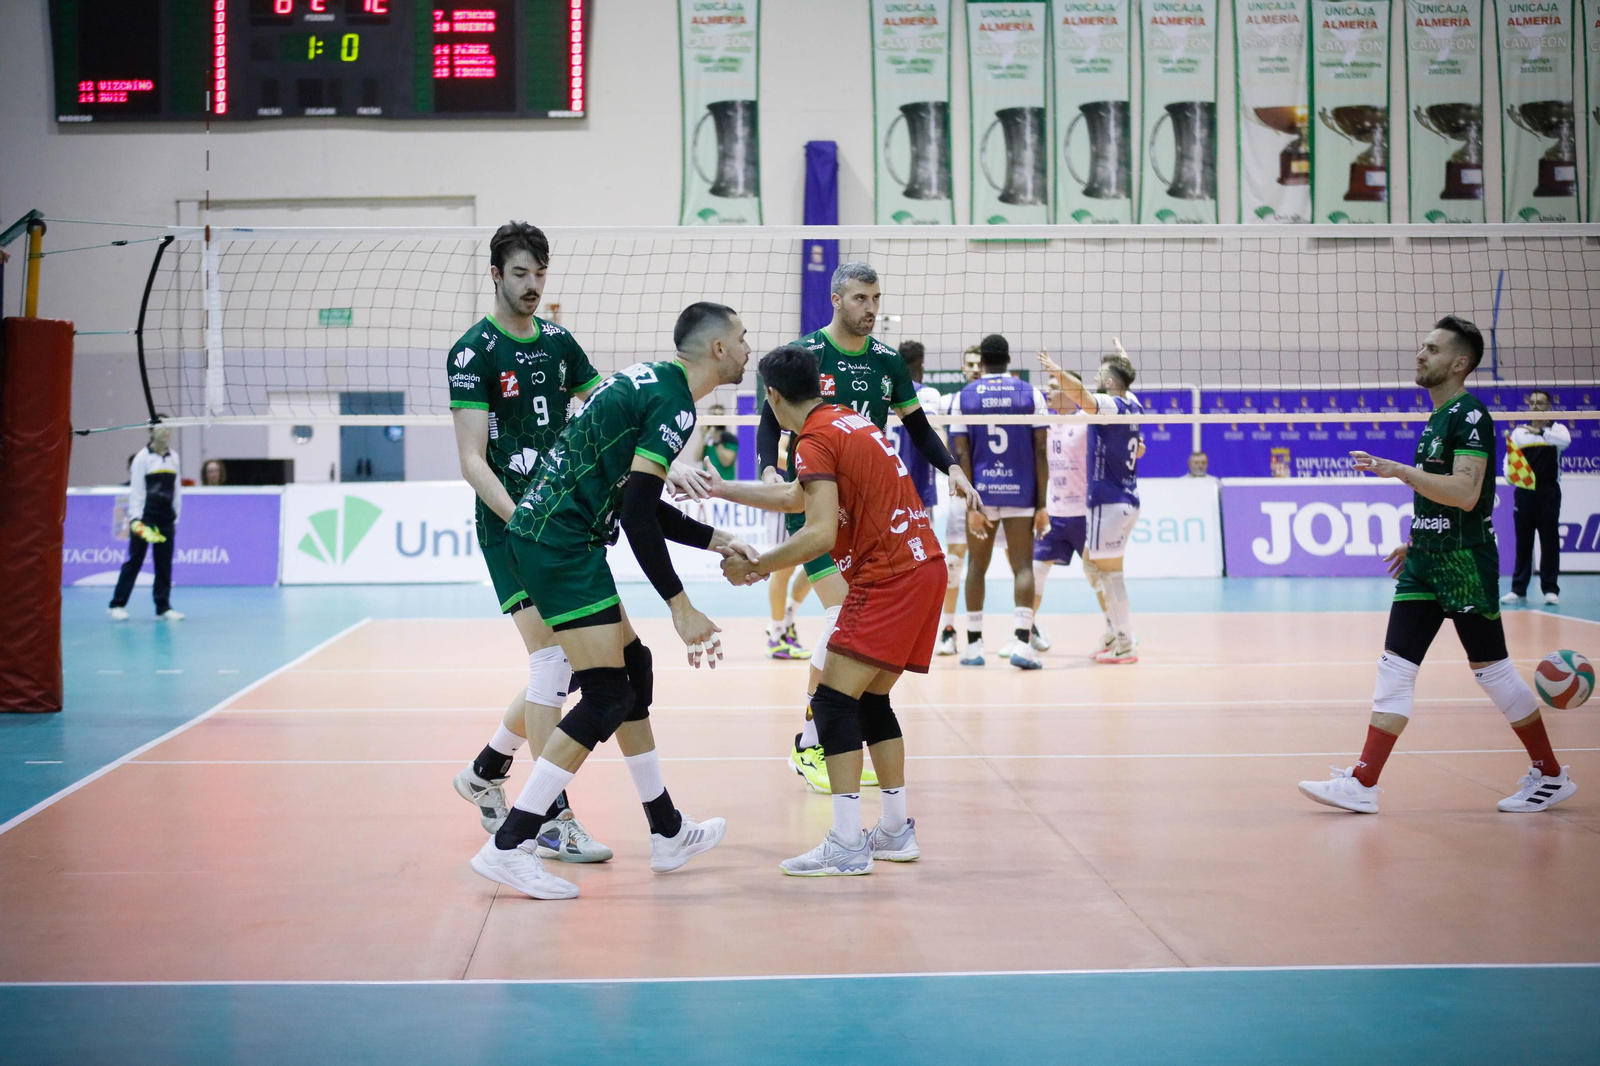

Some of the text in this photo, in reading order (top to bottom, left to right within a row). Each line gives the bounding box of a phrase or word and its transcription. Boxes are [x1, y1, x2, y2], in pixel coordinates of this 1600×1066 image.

[1065, 4, 1116, 12] UNICAJA
[1154, 4, 1204, 12] UNICAJA
[1248, 2, 1296, 11] UNICAJA
[1325, 8, 1376, 16] UNICAJA
[1418, 4, 1468, 13] UNICAJA
[1510, 4, 1558, 12] UNICAJA
[340, 33, 360, 62] 0
[1522, 57, 1550, 65] Superliga
[78, 81, 94, 91] 12
[982, 397, 1012, 408] SERRANO
[533, 396, 550, 426] 9
[850, 400, 872, 422] 14
[988, 424, 1008, 454] 5
[1052, 440, 1062, 454] 18
[870, 431, 908, 478] 5
[1126, 437, 1138, 471] 3
[1131, 518, 1206, 544] san
